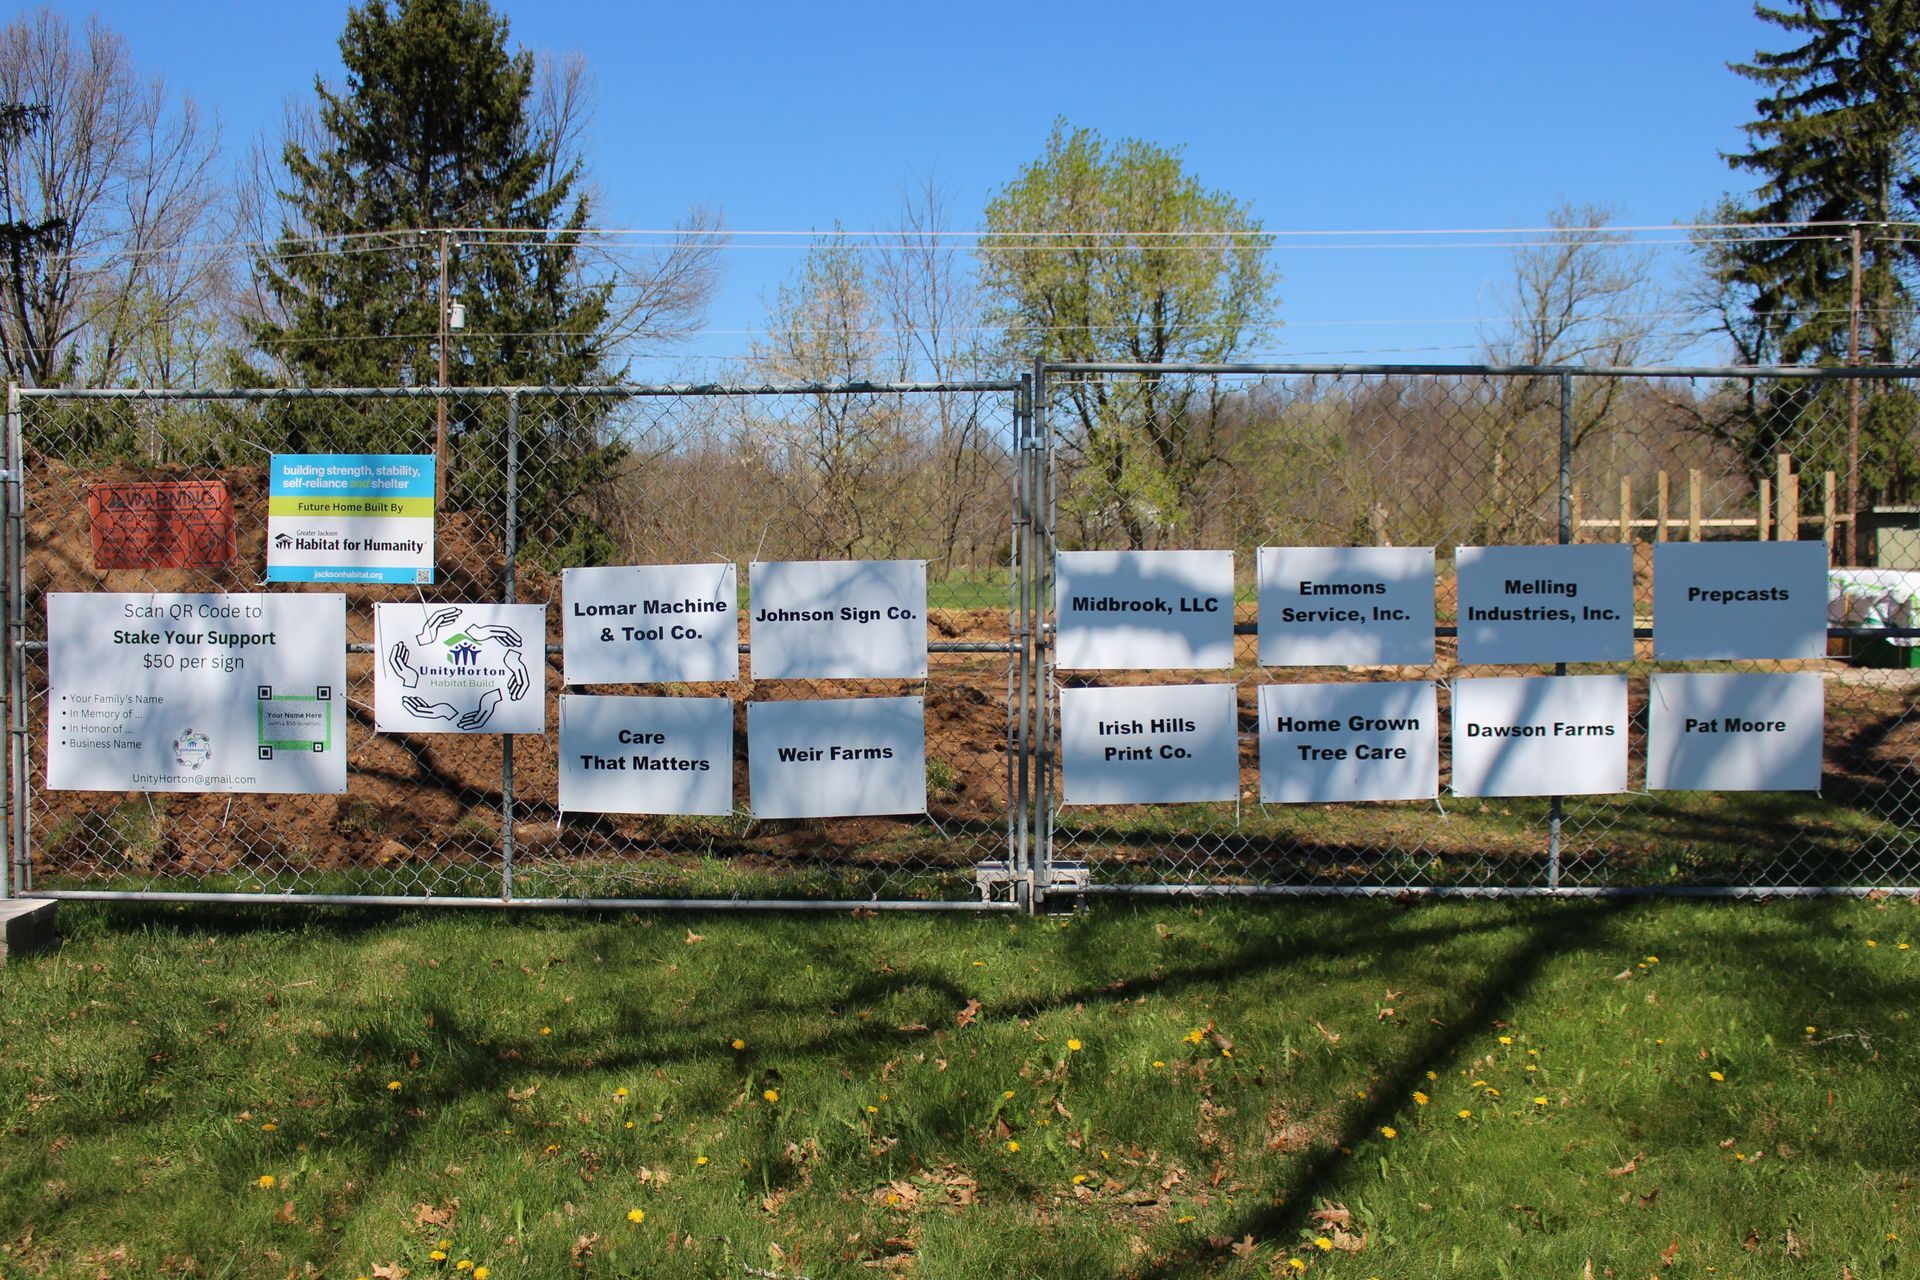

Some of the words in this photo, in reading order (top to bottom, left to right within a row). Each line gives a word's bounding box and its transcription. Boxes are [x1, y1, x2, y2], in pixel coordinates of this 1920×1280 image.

[283, 465, 325, 477] building
[327, 465, 374, 477] strength,
[376, 466, 421, 478] stability,
[283, 478, 348, 488] self-reliance
[351, 479, 370, 488] and
[371, 479, 409, 489] shelter
[298, 503, 330, 511] Future
[333, 503, 362, 512] Home
[365, 503, 388, 512] Built
[391, 504, 404, 514] By
[296, 538, 340, 550] Habitat
[344, 539, 361, 550] for
[364, 540, 424, 554] Humanity
[314, 570, 383, 580] jacksonhabitat.org
[1300, 581, 1386, 596] Emmons
[1504, 580, 1578, 599] Melling
[1688, 587, 1790, 603] Prepcasts
[124, 604, 163, 618] Scan
[169, 604, 192, 621] QR
[198, 604, 240, 619] Code
[246, 605, 262, 619] to
[574, 602, 637, 617] Lomar
[643, 598, 727, 615] Machine
[1072, 597, 1173, 615] Midbrook,
[1180, 598, 1219, 613] LLC
[755, 609, 834, 623] Johnson
[839, 607, 881, 624] Sign
[887, 606, 917, 621] Co.
[1282, 607, 1366, 624] Service,
[1372, 606, 1410, 621] Inc.
[1468, 606, 1576, 624] Industries,
[1583, 606, 1621, 621] Inc.
[114, 631, 160, 645] Stake
[165, 631, 203, 645] Your
[207, 631, 276, 648] Support
[600, 628, 615, 643] &
[621, 627, 664, 642] Tool
[671, 626, 703, 640] Co.
[143, 654, 175, 669] $50
[180, 657, 207, 672] per
[212, 655, 245, 672] sign
[420, 666, 506, 677] UnityHorton
[431, 679, 468, 687] Habitat
[470, 679, 495, 688] Build
[70, 694, 92, 703] Your
[94, 694, 133, 706] Family's
[136, 695, 164, 704] Name
[70, 709, 79, 718] In
[81, 710, 120, 720] Memory
[122, 709, 133, 719] of
[70, 724, 79, 733] In
[81, 725, 111, 734] Honor
[113, 724, 123, 734] of
[1099, 720, 1143, 735] Irish
[1150, 718, 1196, 734] Hills
[1277, 717, 1341, 733] Home
[1348, 716, 1420, 732] Grown
[1467, 722, 1546, 738] Dawson
[1553, 722, 1615, 737] Farms
[1685, 718, 1718, 734] Pat
[1724, 718, 1786, 733] Moore
[70, 739, 111, 749] Business
[114, 740, 142, 749] Name
[618, 730, 665, 745] Care
[778, 747, 824, 762] Weir
[830, 745, 893, 761] Farms
[1104, 746, 1152, 761] Print
[1159, 745, 1192, 759] Co.
[1298, 745, 1347, 761] Tree
[1354, 745, 1407, 760] Care
[581, 755, 626, 771] That
[632, 755, 710, 772] Matters
[133, 774, 256, 785] UnityHorton@gmail.com
